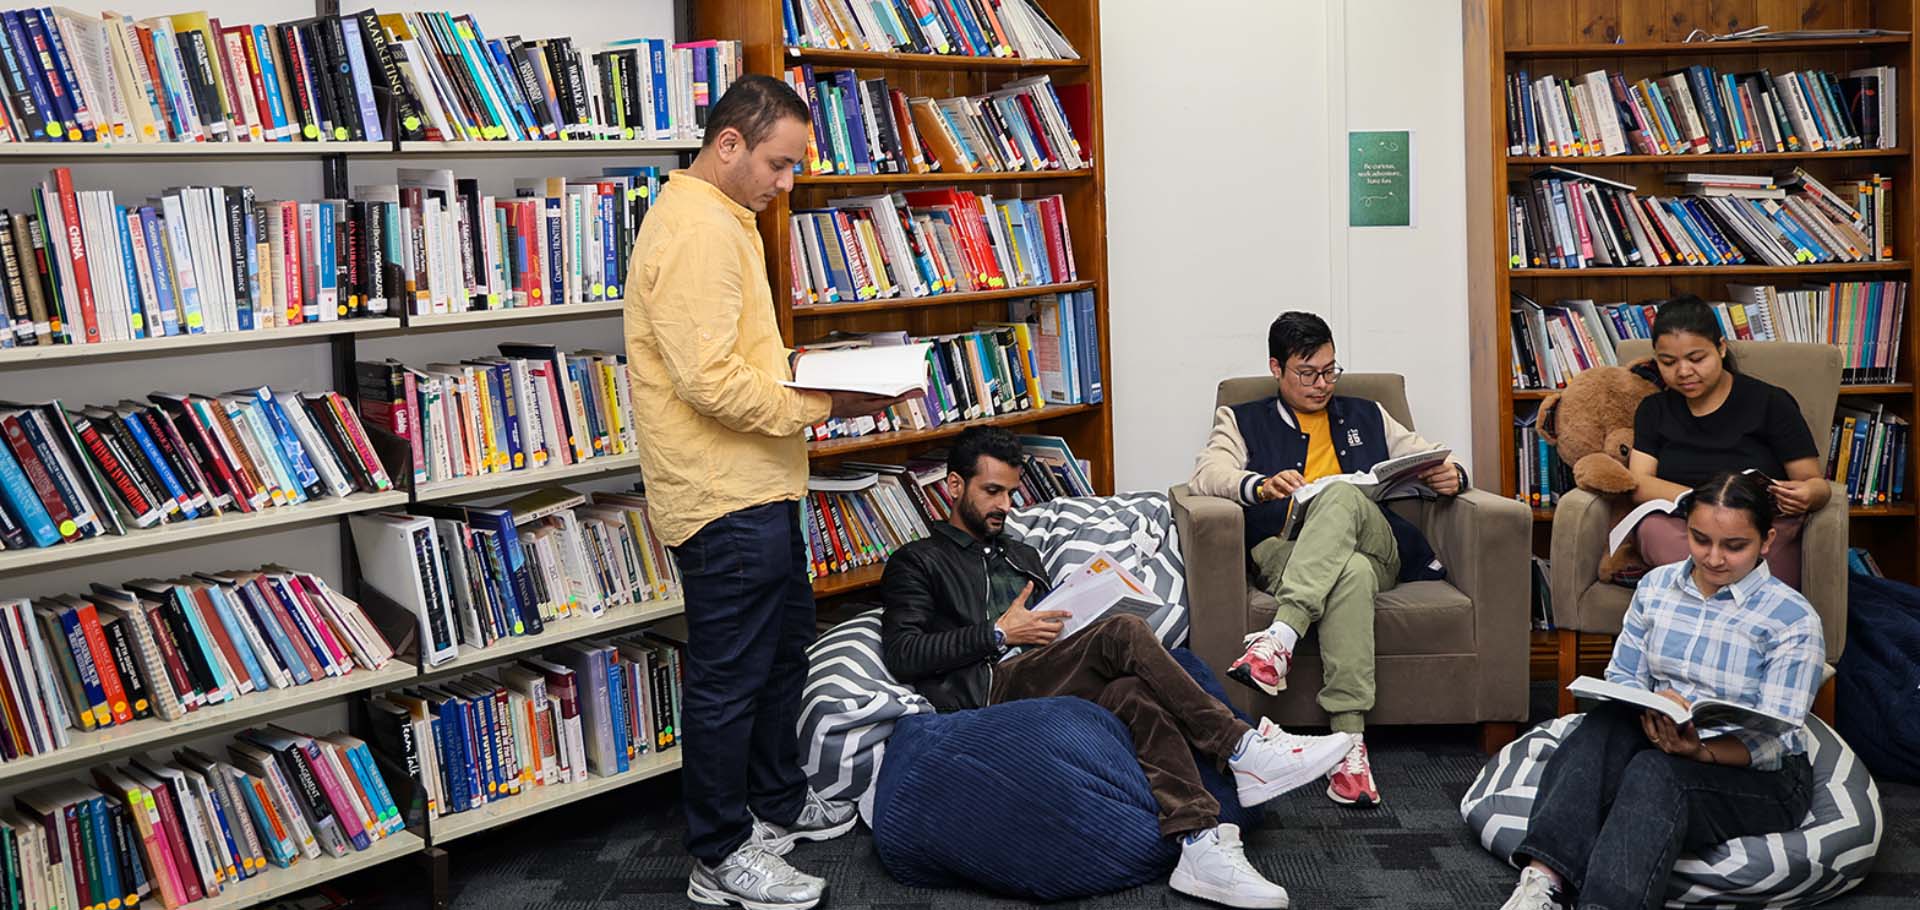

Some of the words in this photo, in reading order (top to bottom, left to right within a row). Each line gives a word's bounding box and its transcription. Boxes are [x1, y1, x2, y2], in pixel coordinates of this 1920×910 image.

[362, 11, 406, 96] MARKETING
[1789, 76, 1809, 121] Entrepreneurship
[230, 204, 244, 259] Multinational
[370, 205, 380, 229] Wilfred
[550, 216, 561, 250] FRONTIERS
[67, 224, 86, 260] CHINA
[372, 229, 381, 250] Brown
[460, 223, 473, 280] Management
[235, 259, 247, 292] Finance
[373, 249, 384, 300] ORGANIZATIO
[816, 509, 827, 528] BEYOND
[822, 531, 834, 556] AMBITION
[830, 507, 840, 526] BEYOND
[837, 527, 850, 552] AMBITION
[517, 576, 532, 606] FINANCE
[111, 624, 122, 639] THE
[116, 637, 128, 656] FIFTH
[71, 622, 84, 637] THE
[86, 662, 102, 687] FACTOR
[123, 655, 141, 690] DISCIPLINE
[402, 722, 412, 752] Team
[407, 752, 419, 777] Talk
[481, 734, 494, 770] FUTURE
[493, 730, 507, 766] FUTURE
[291, 747, 320, 799] MANAGEMENT
[734, 871, 758, 890] N
